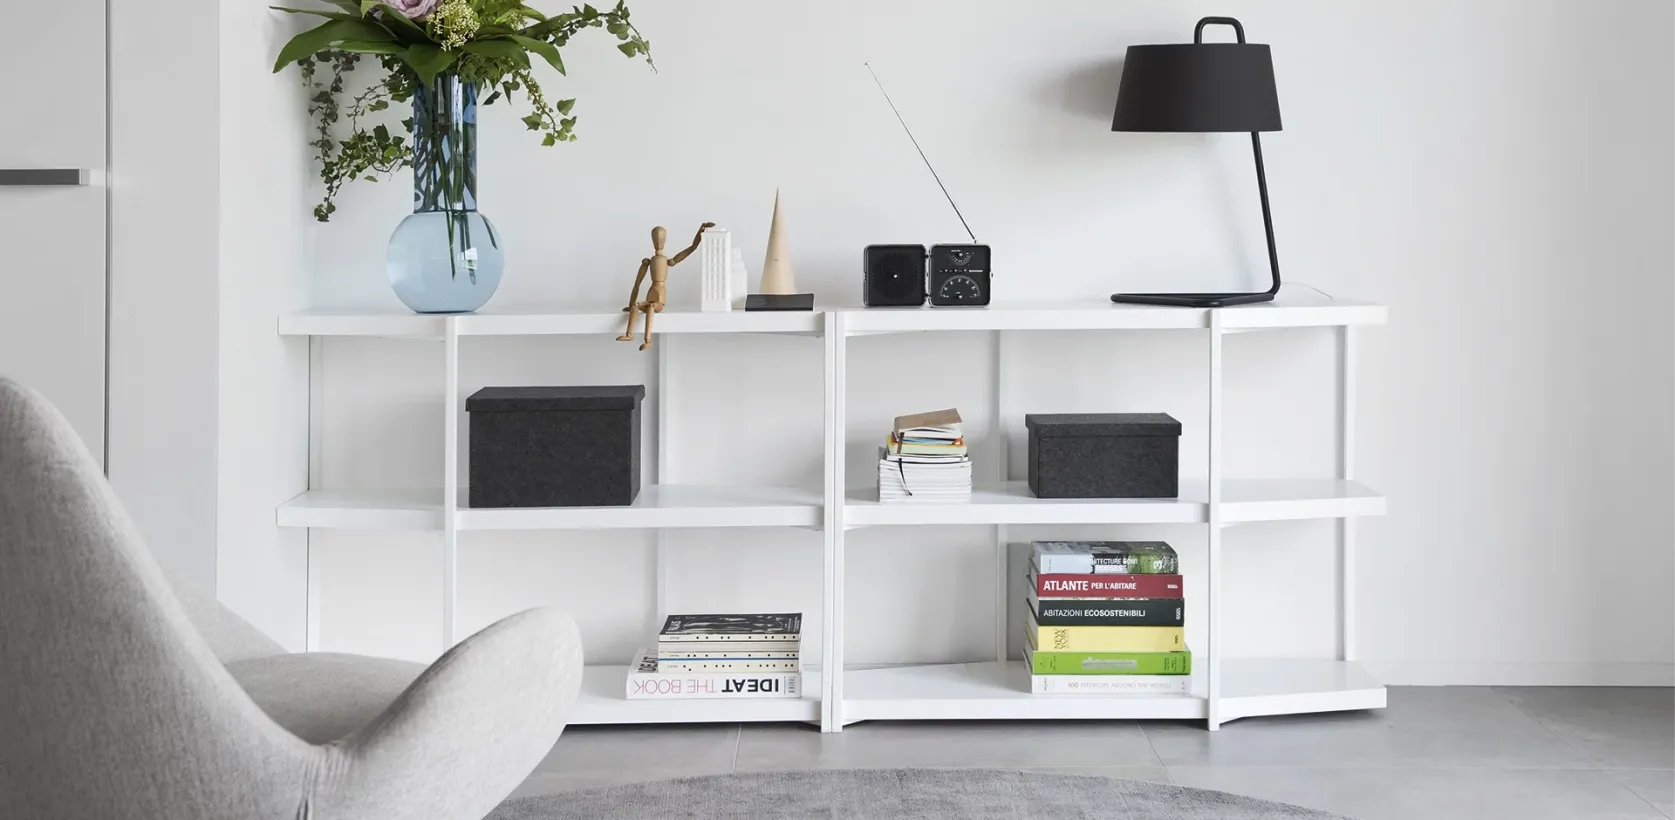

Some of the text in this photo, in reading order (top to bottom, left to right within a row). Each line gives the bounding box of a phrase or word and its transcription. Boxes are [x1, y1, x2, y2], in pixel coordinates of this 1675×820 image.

[1043, 580, 1088, 590] ATLANTE
[1105, 582, 1137, 590] L'ABITARE
[1043, 609, 1145, 617] ABITAZIONI ECOSOSTENIBILI
[633, 679, 682, 694] BOOK
[687, 678, 717, 694] THE
[721, 679, 779, 692] IDEAT
